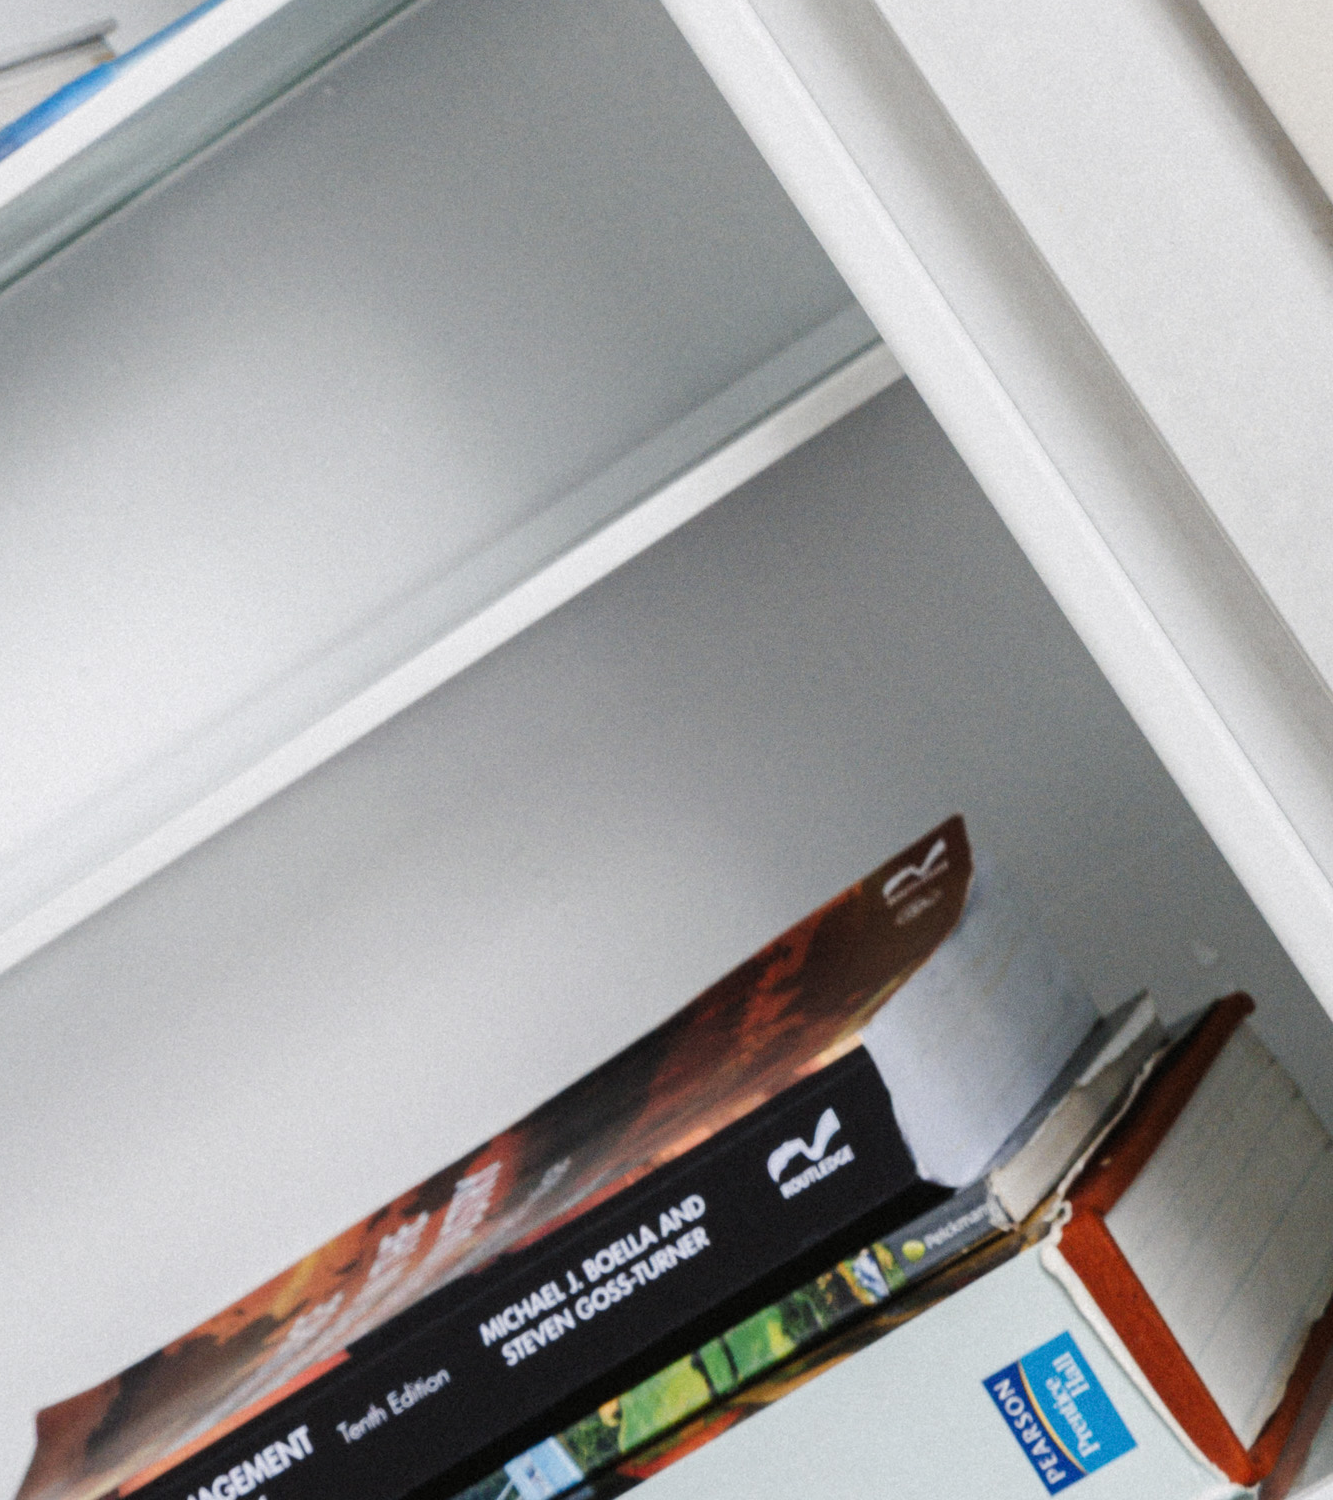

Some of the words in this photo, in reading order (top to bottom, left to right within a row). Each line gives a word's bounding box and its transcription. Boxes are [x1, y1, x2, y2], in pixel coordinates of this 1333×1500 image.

[779, 1143, 856, 1201] ROUTLEDGE
[477, 1281, 570, 1348] MICHAEL
[566, 1264, 587, 1296] J.
[581, 1223, 659, 1285] BOELLA
[656, 1193, 707, 1237] AND
[500, 1308, 579, 1369] STEVEN
[574, 1226, 713, 1323] GOSS-TURNER
[335, 1398, 390, 1446] Tenth
[385, 1368, 451, 1418] Edition
[1045, 1375, 1102, 1459] Prentice
[1052, 1351, 1091, 1399] Hall
[993, 1378, 1066, 1485] PEARSON
